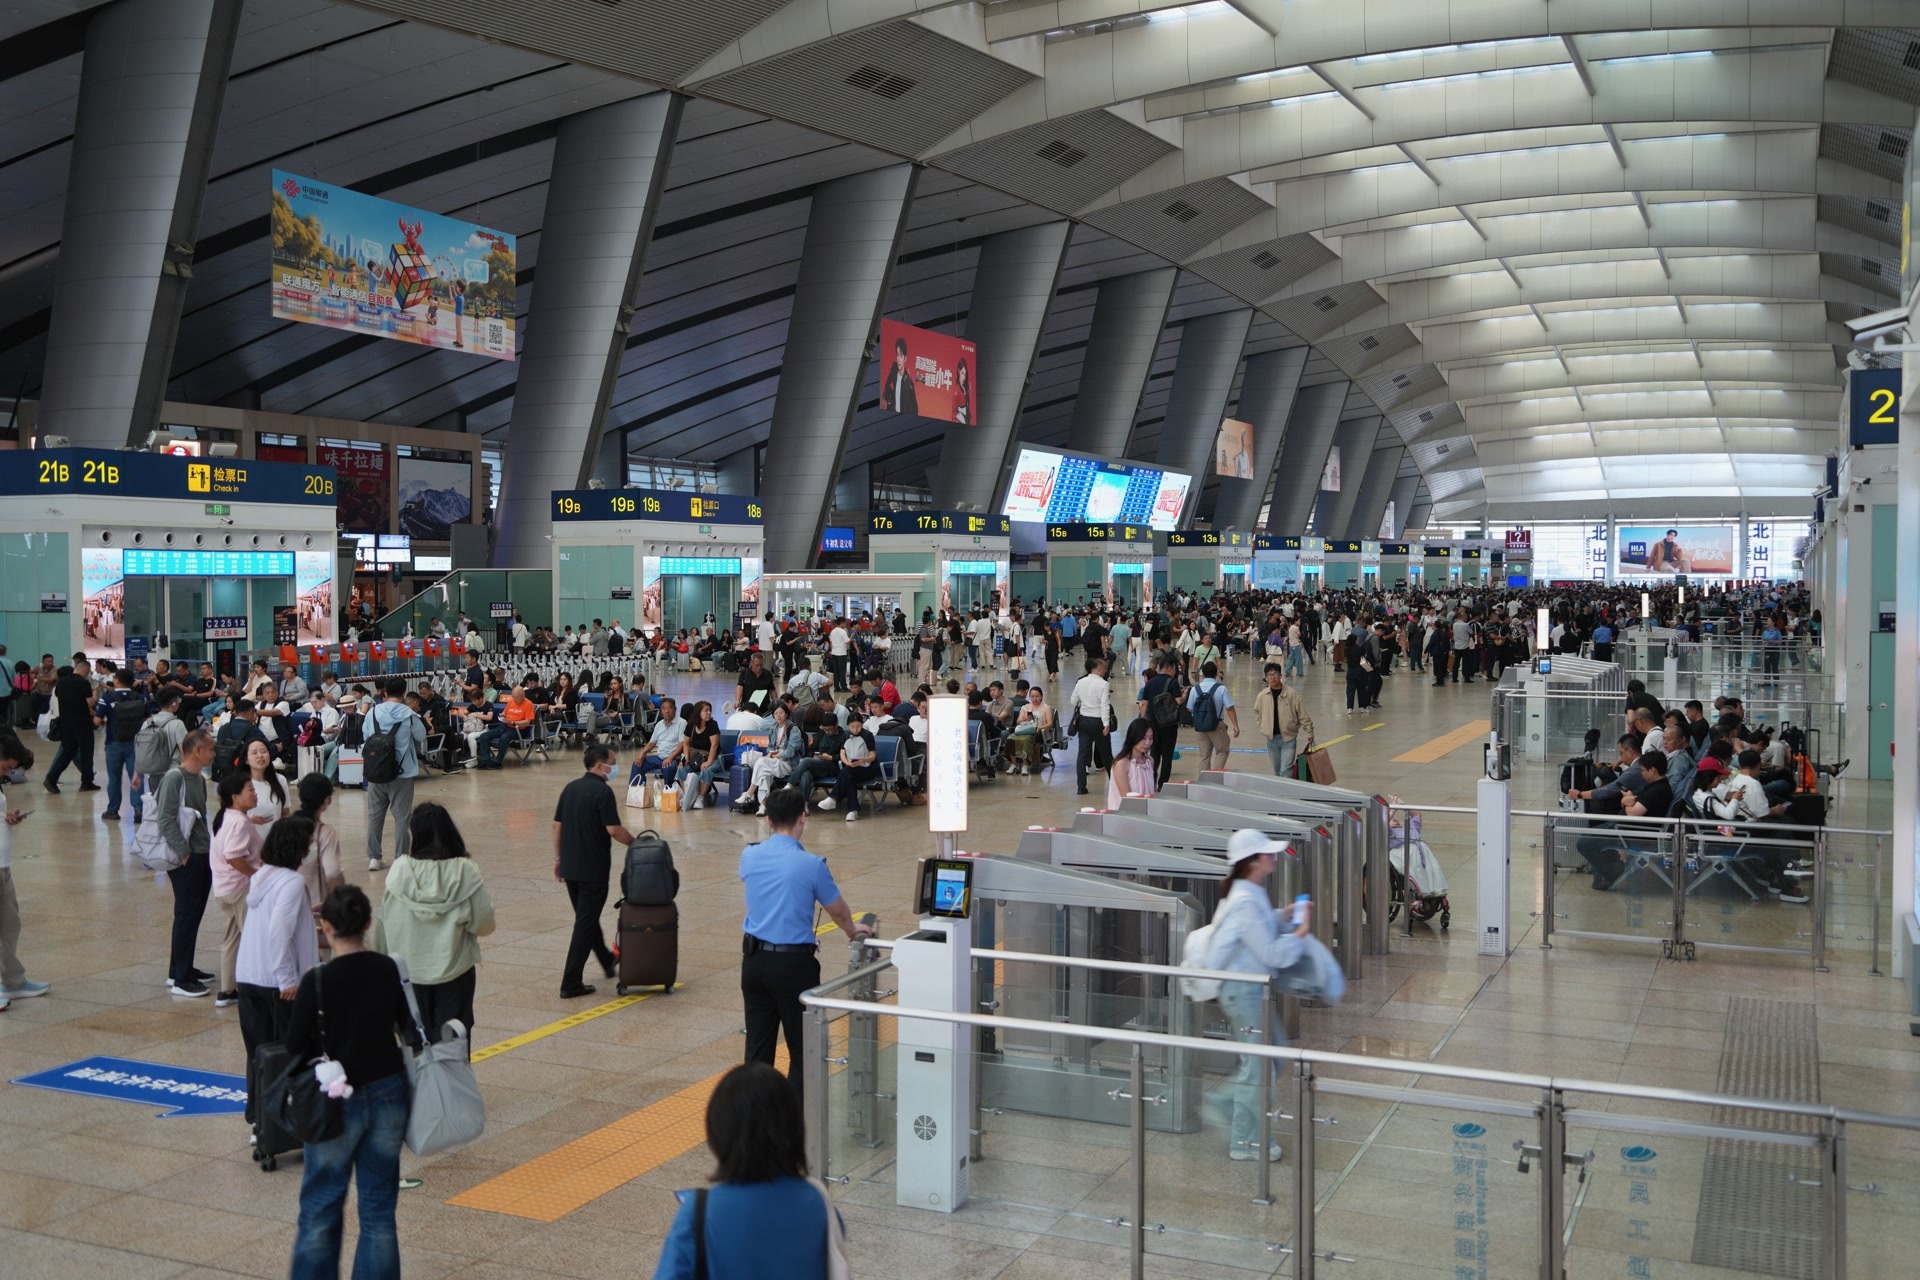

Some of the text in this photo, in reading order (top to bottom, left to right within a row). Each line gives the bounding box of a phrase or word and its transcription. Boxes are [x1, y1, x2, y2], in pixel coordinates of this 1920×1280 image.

[282, 273, 321, 293] 联通魔方
[39, 460, 69, 484] 21B
[83, 460, 120, 484] 21B
[213, 467, 247, 483] 检票口
[213, 484, 240, 493] Check in
[304, 475, 334, 495] 20B
[557, 498, 581, 514] 19B
[611, 497, 635, 512] 19B
[643, 497, 660, 513] 19B
[703, 499, 719, 510] 检票口
[747, 504, 762, 518] 18B
[873, 517, 893, 529] 17B
[917, 516, 937, 529] 17B
[942, 516, 952, 529] 17B
[1050, 527, 1067, 538] 15B
[1087, 527, 1104, 537] 15B
[1202, 534, 1218, 543] 13B
[1171, 535, 1185, 543] 13B
[1285, 539, 1298, 547] 11B
[1592, 525, 1607, 580] 北出口
[1753, 523, 1769, 579] 北出口
[206, 619, 246, 628] C2251次
[214, 629, 239, 637] 在此候车
